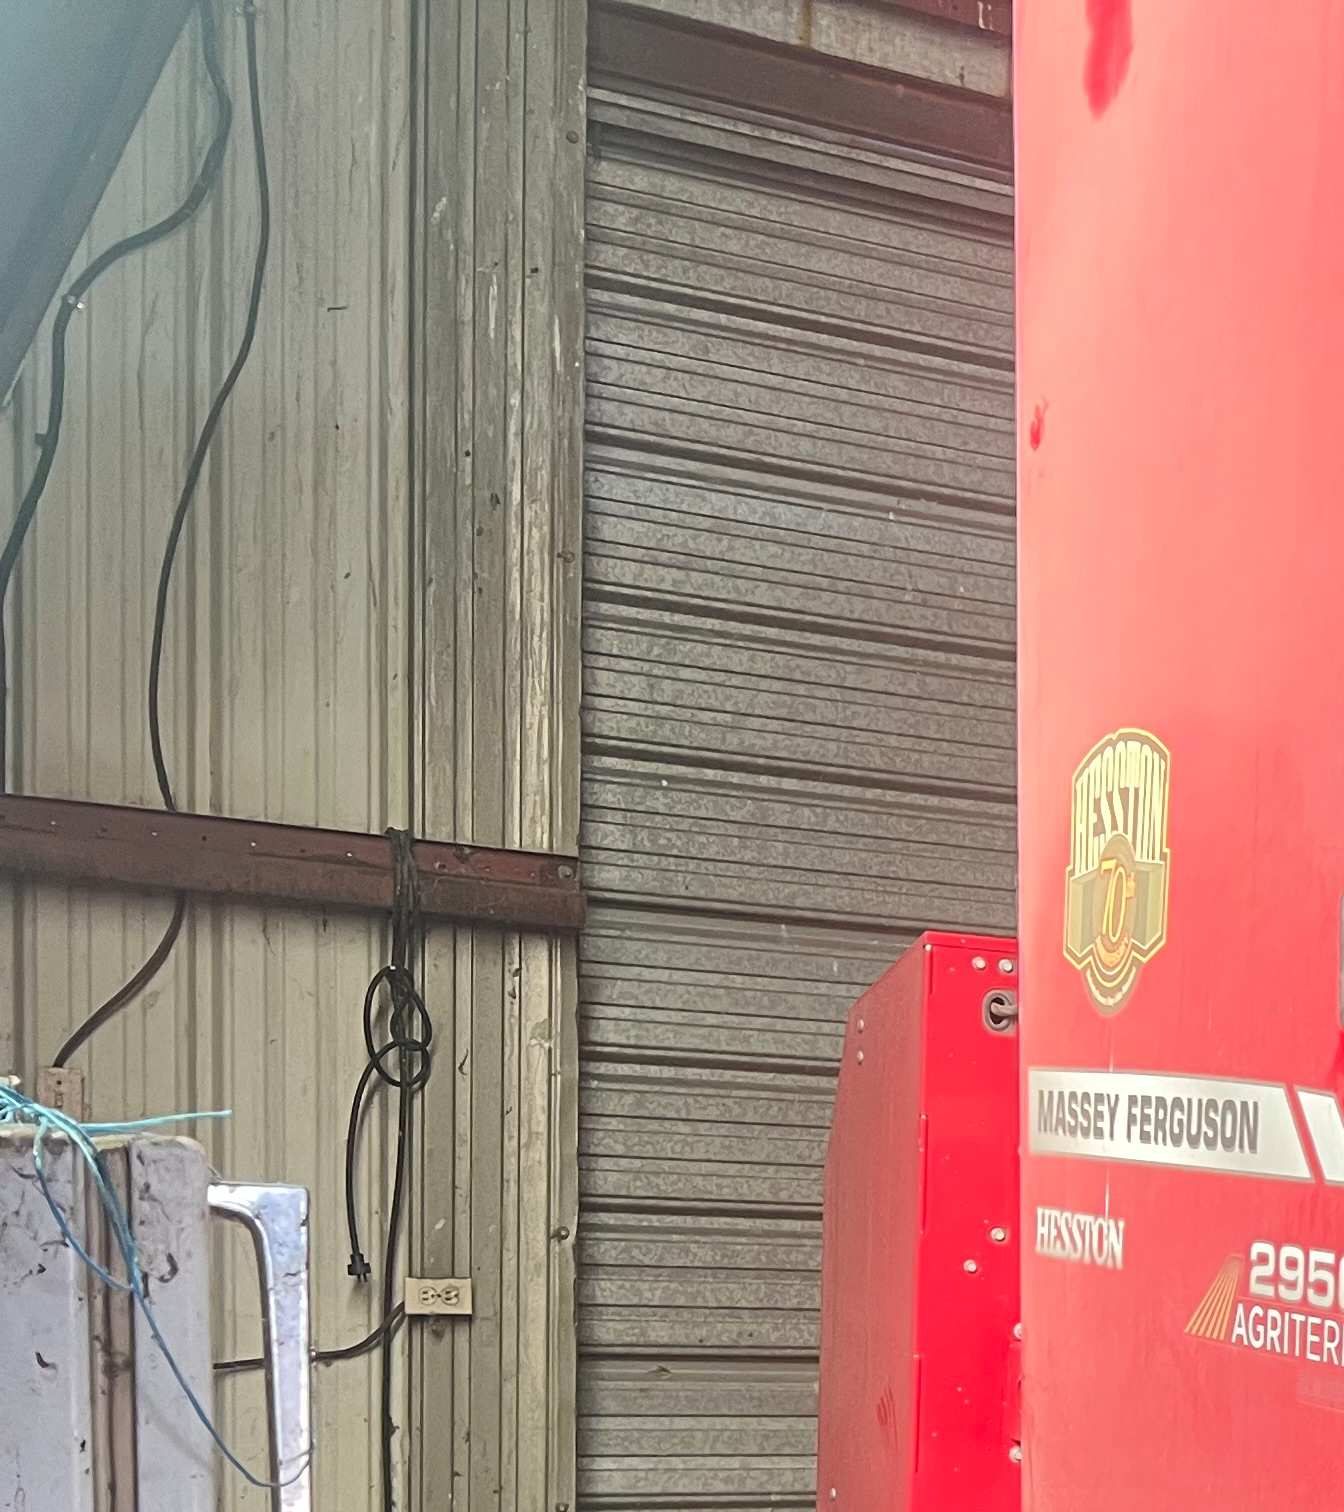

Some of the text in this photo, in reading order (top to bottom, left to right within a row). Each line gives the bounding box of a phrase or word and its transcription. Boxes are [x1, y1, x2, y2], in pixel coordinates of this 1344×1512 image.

[1073, 740, 1166, 879] HESSTON
[1037, 1089, 1258, 1154] MASSEY FERGUSON
[1036, 1207, 1125, 1270] HESSTON
